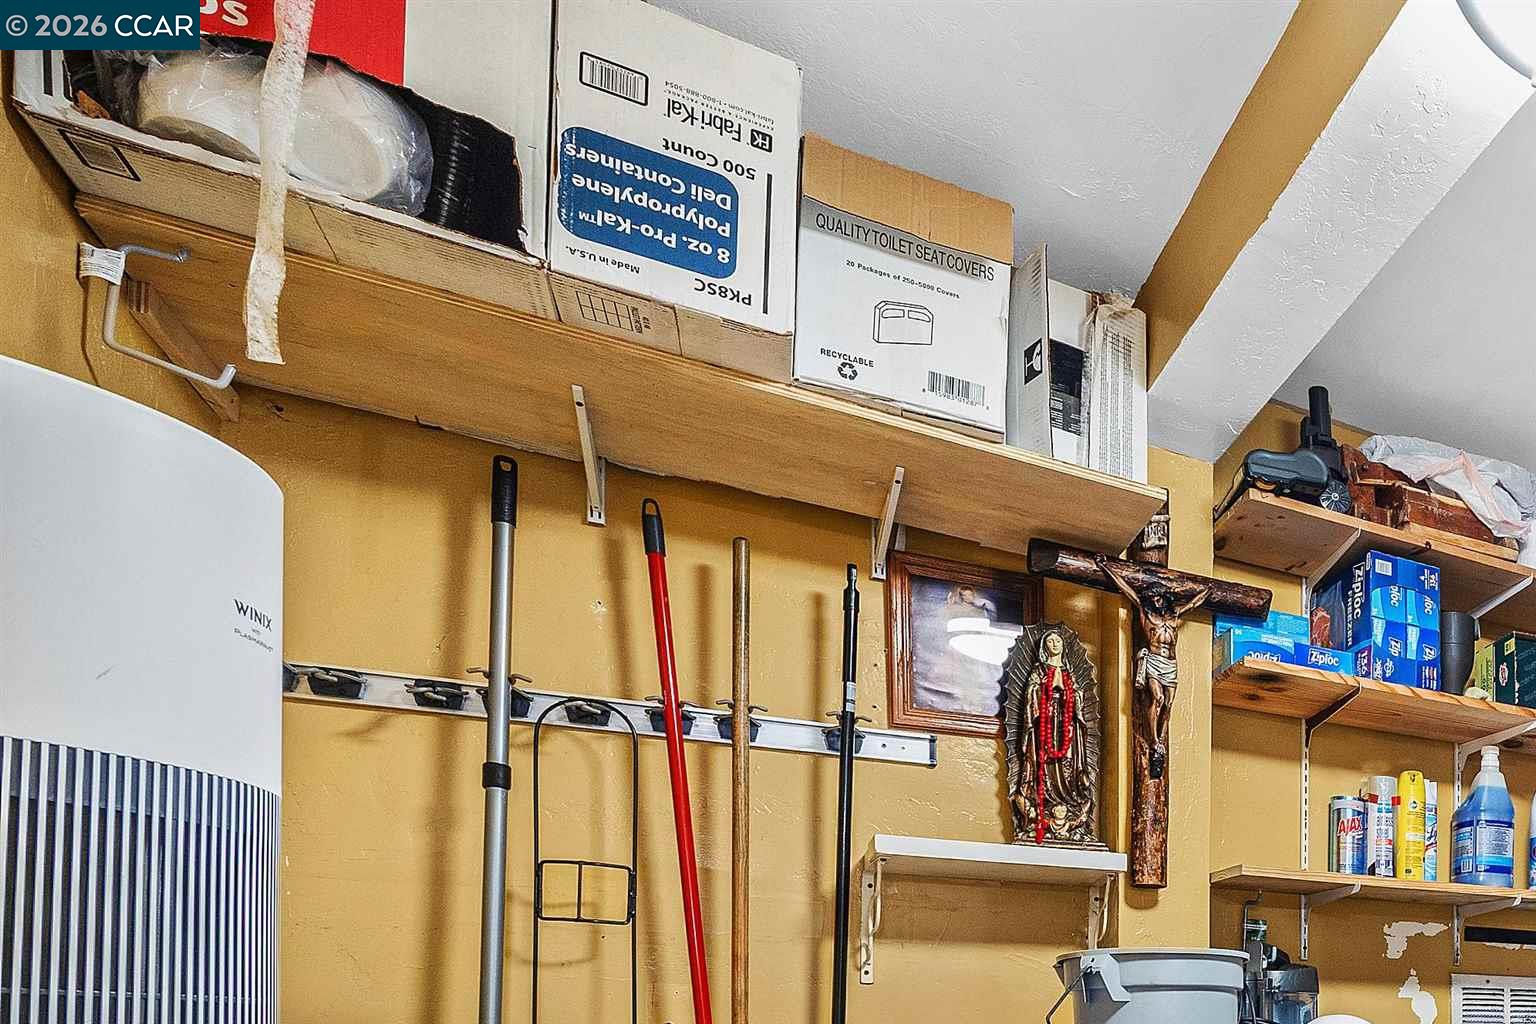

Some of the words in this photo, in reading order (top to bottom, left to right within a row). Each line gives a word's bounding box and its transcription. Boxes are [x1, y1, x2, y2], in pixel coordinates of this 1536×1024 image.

[662, 137, 719, 168] Count
[564, 142, 686, 194] Containers
[724, 161, 756, 180] 500
[571, 174, 731, 238] Polypropylene
[691, 183, 732, 211] Deli
[565, 245, 597, 263] U.S.A.
[682, 235, 713, 256] oz.
[717, 248, 730, 264] 8
[815, 213, 871, 242] QUALITY
[872, 231, 914, 255] TOILET
[915, 244, 946, 266] SEAT
[947, 254, 995, 282] COVERS
[599, 255, 611, 266] in
[612, 257, 640, 274] Made
[694, 278, 752, 306] PK8SC
[820, 348, 874, 368] RECYCLABLE
[1353, 565, 1363, 619] Ziploc
[233, 598, 272, 632] WINIX
[1310, 650, 1340, 666] Ziploc
[1338, 816, 1362, 834] AJAX
